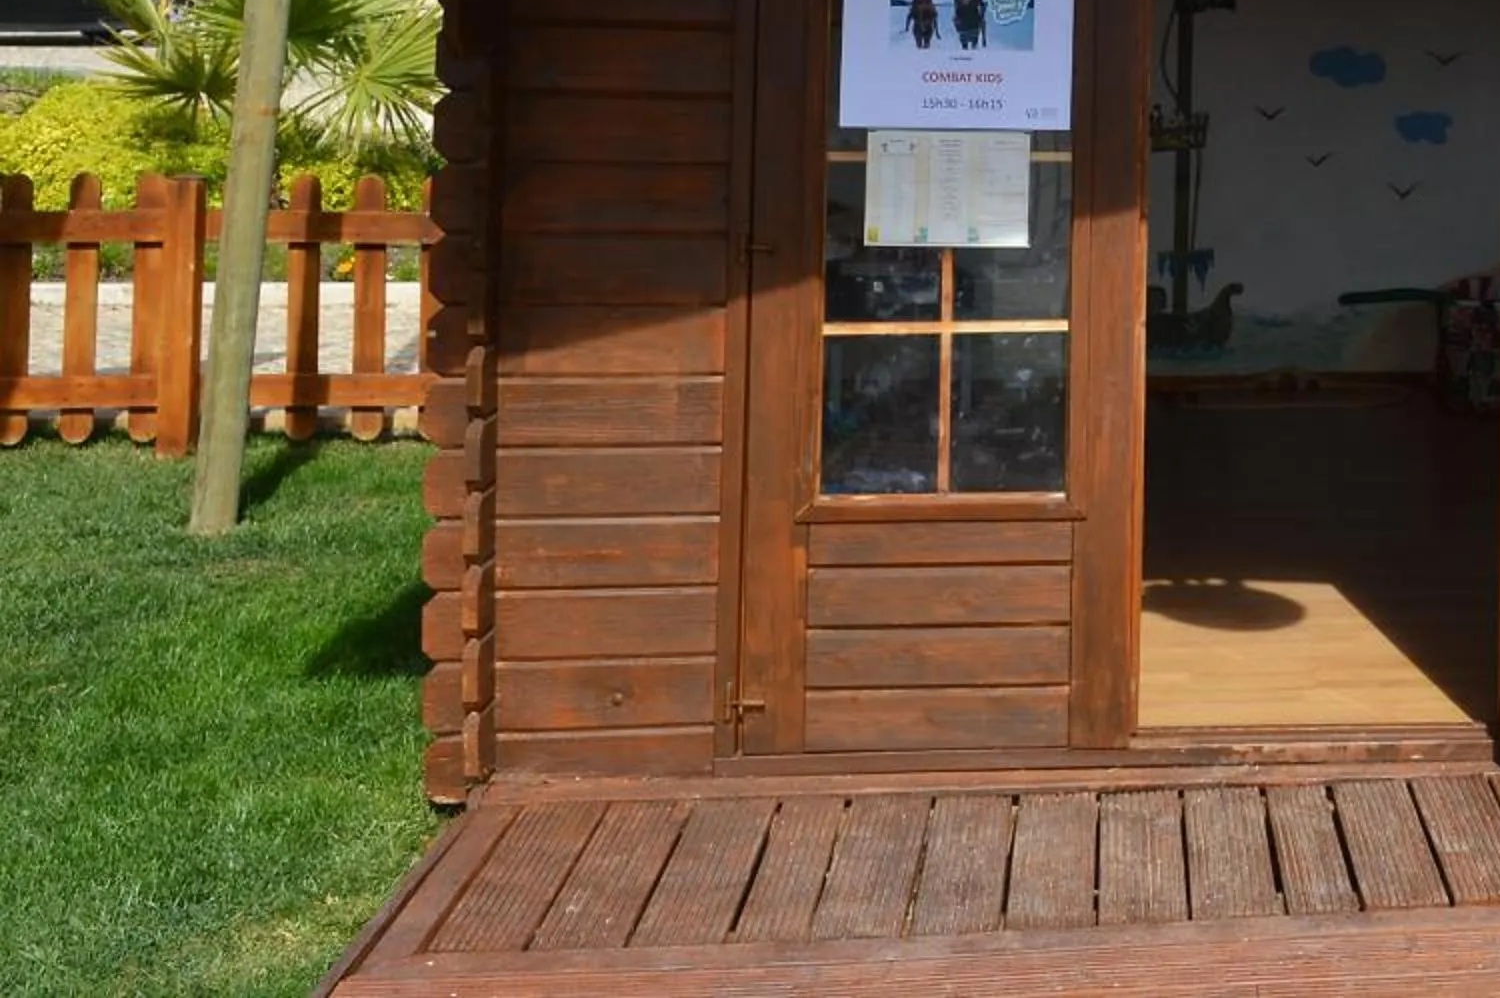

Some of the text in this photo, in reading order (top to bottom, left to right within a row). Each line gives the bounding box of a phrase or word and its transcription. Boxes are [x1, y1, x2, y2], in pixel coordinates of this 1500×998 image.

[922, 71, 1004, 85] COMBAT KIDS
[921, 97, 957, 109] 15h30
